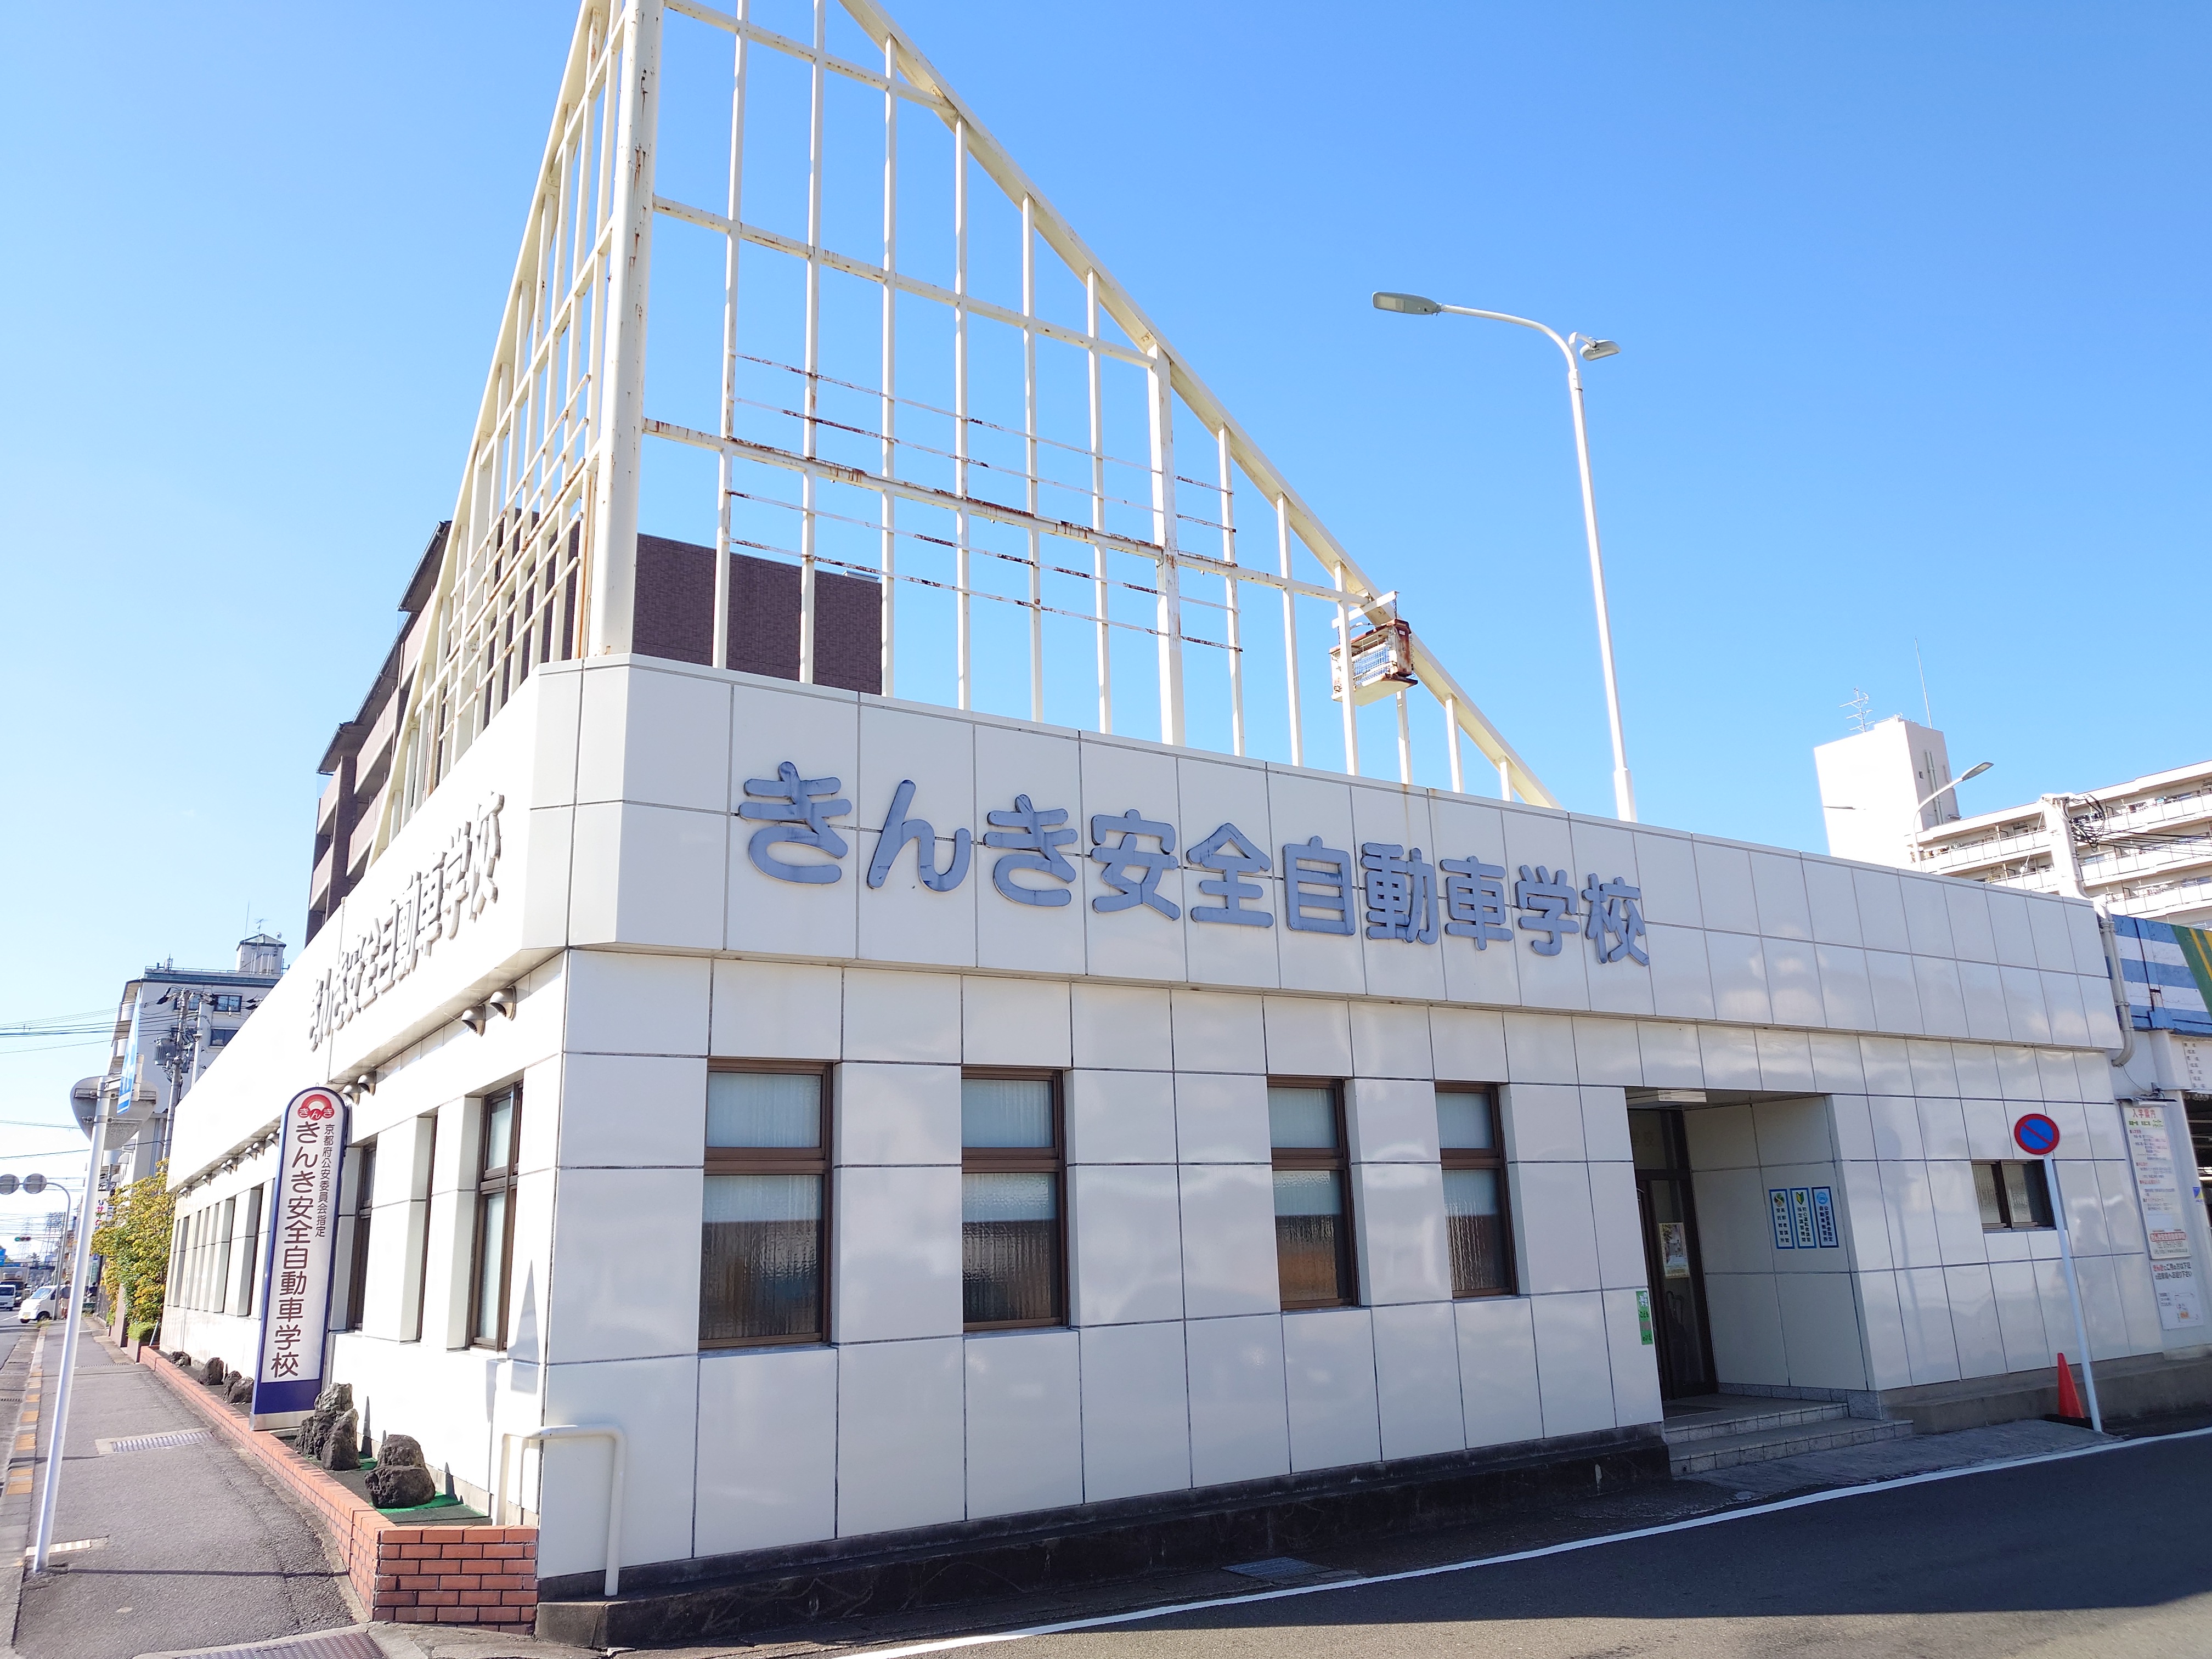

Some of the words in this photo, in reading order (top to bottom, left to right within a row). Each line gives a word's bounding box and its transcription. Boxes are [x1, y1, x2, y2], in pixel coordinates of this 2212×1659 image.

[738, 761, 1649, 966] きんき安全自動車学校
[300, 1108, 332, 1119] きんき
[315, 1124, 335, 1238] 京都府公安委員会指定
[271, 1121, 320, 1378] きんき安全自動車学校
